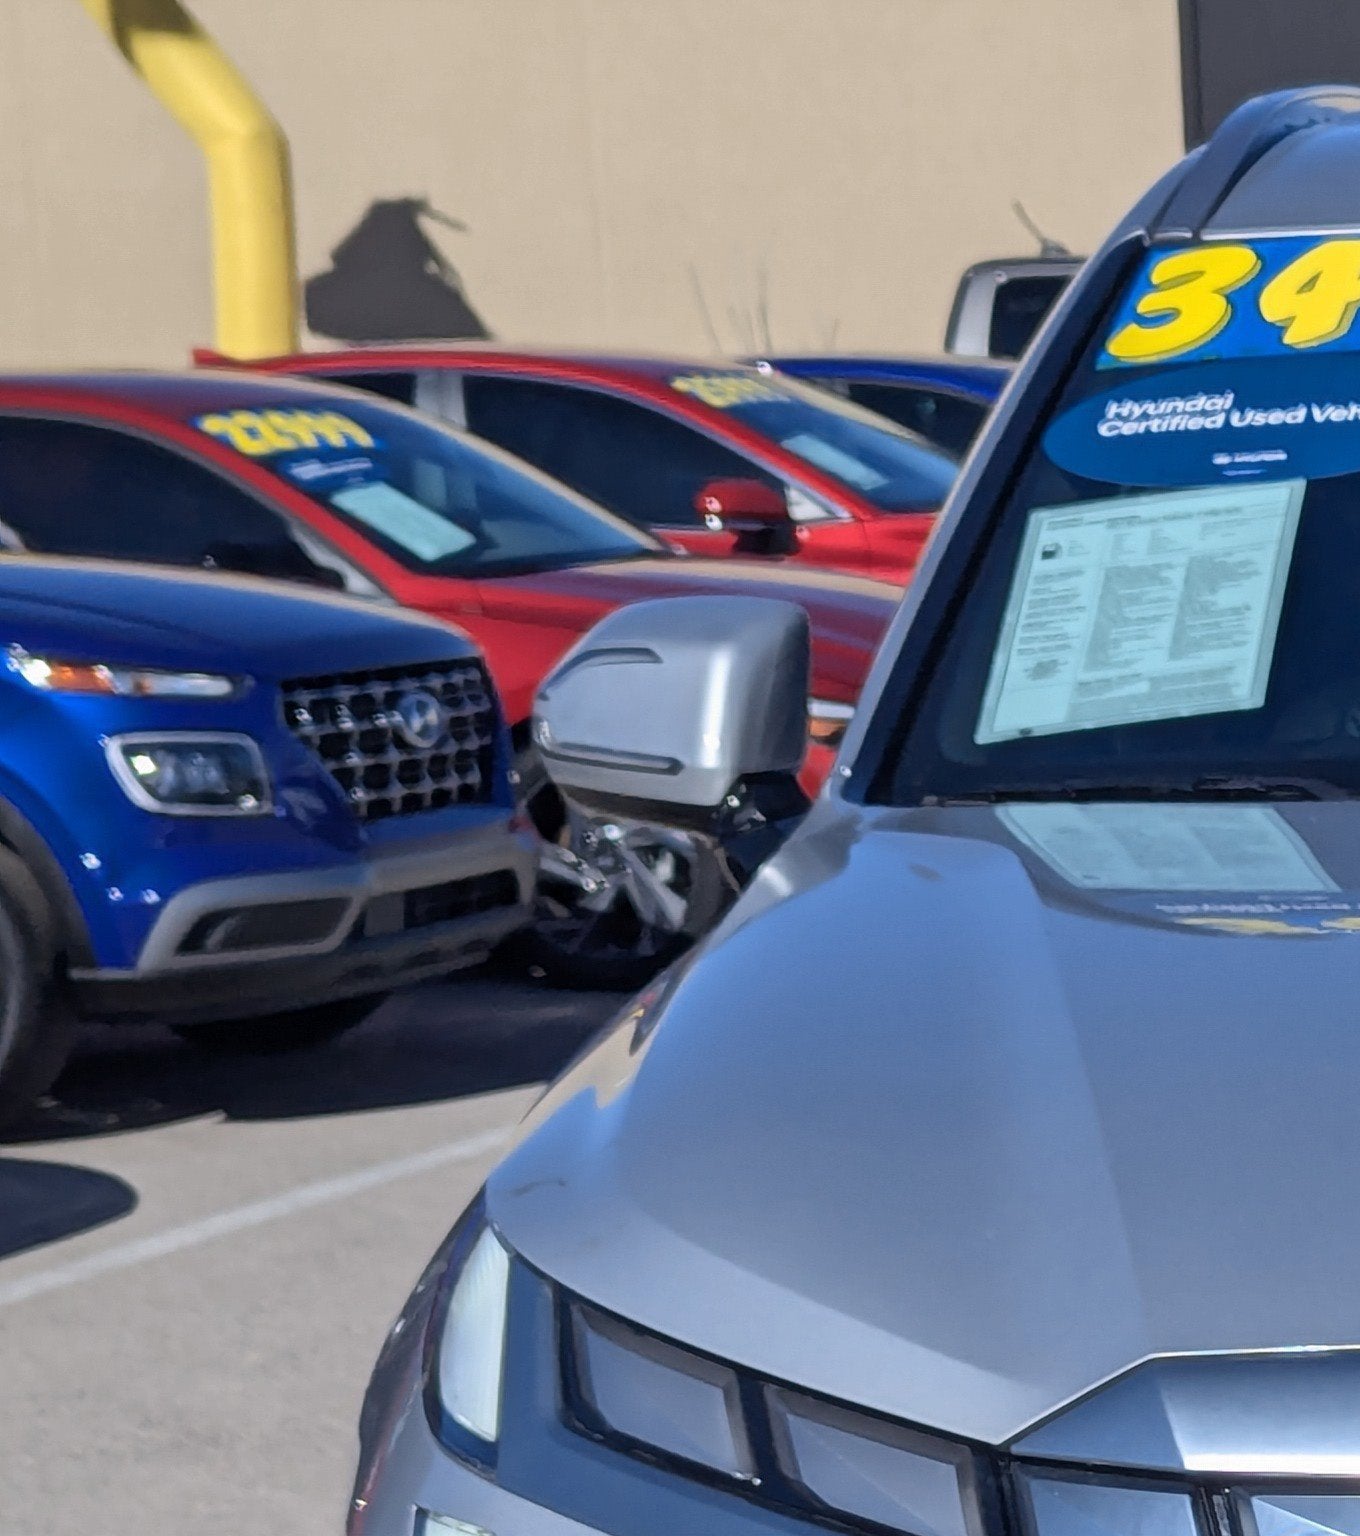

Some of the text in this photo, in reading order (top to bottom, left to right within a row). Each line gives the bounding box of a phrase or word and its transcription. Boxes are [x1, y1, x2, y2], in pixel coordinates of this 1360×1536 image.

[1097, 411, 1224, 437] Certified
[1229, 403, 1306, 428] Used
[1105, 389, 1235, 422] Hyundai
